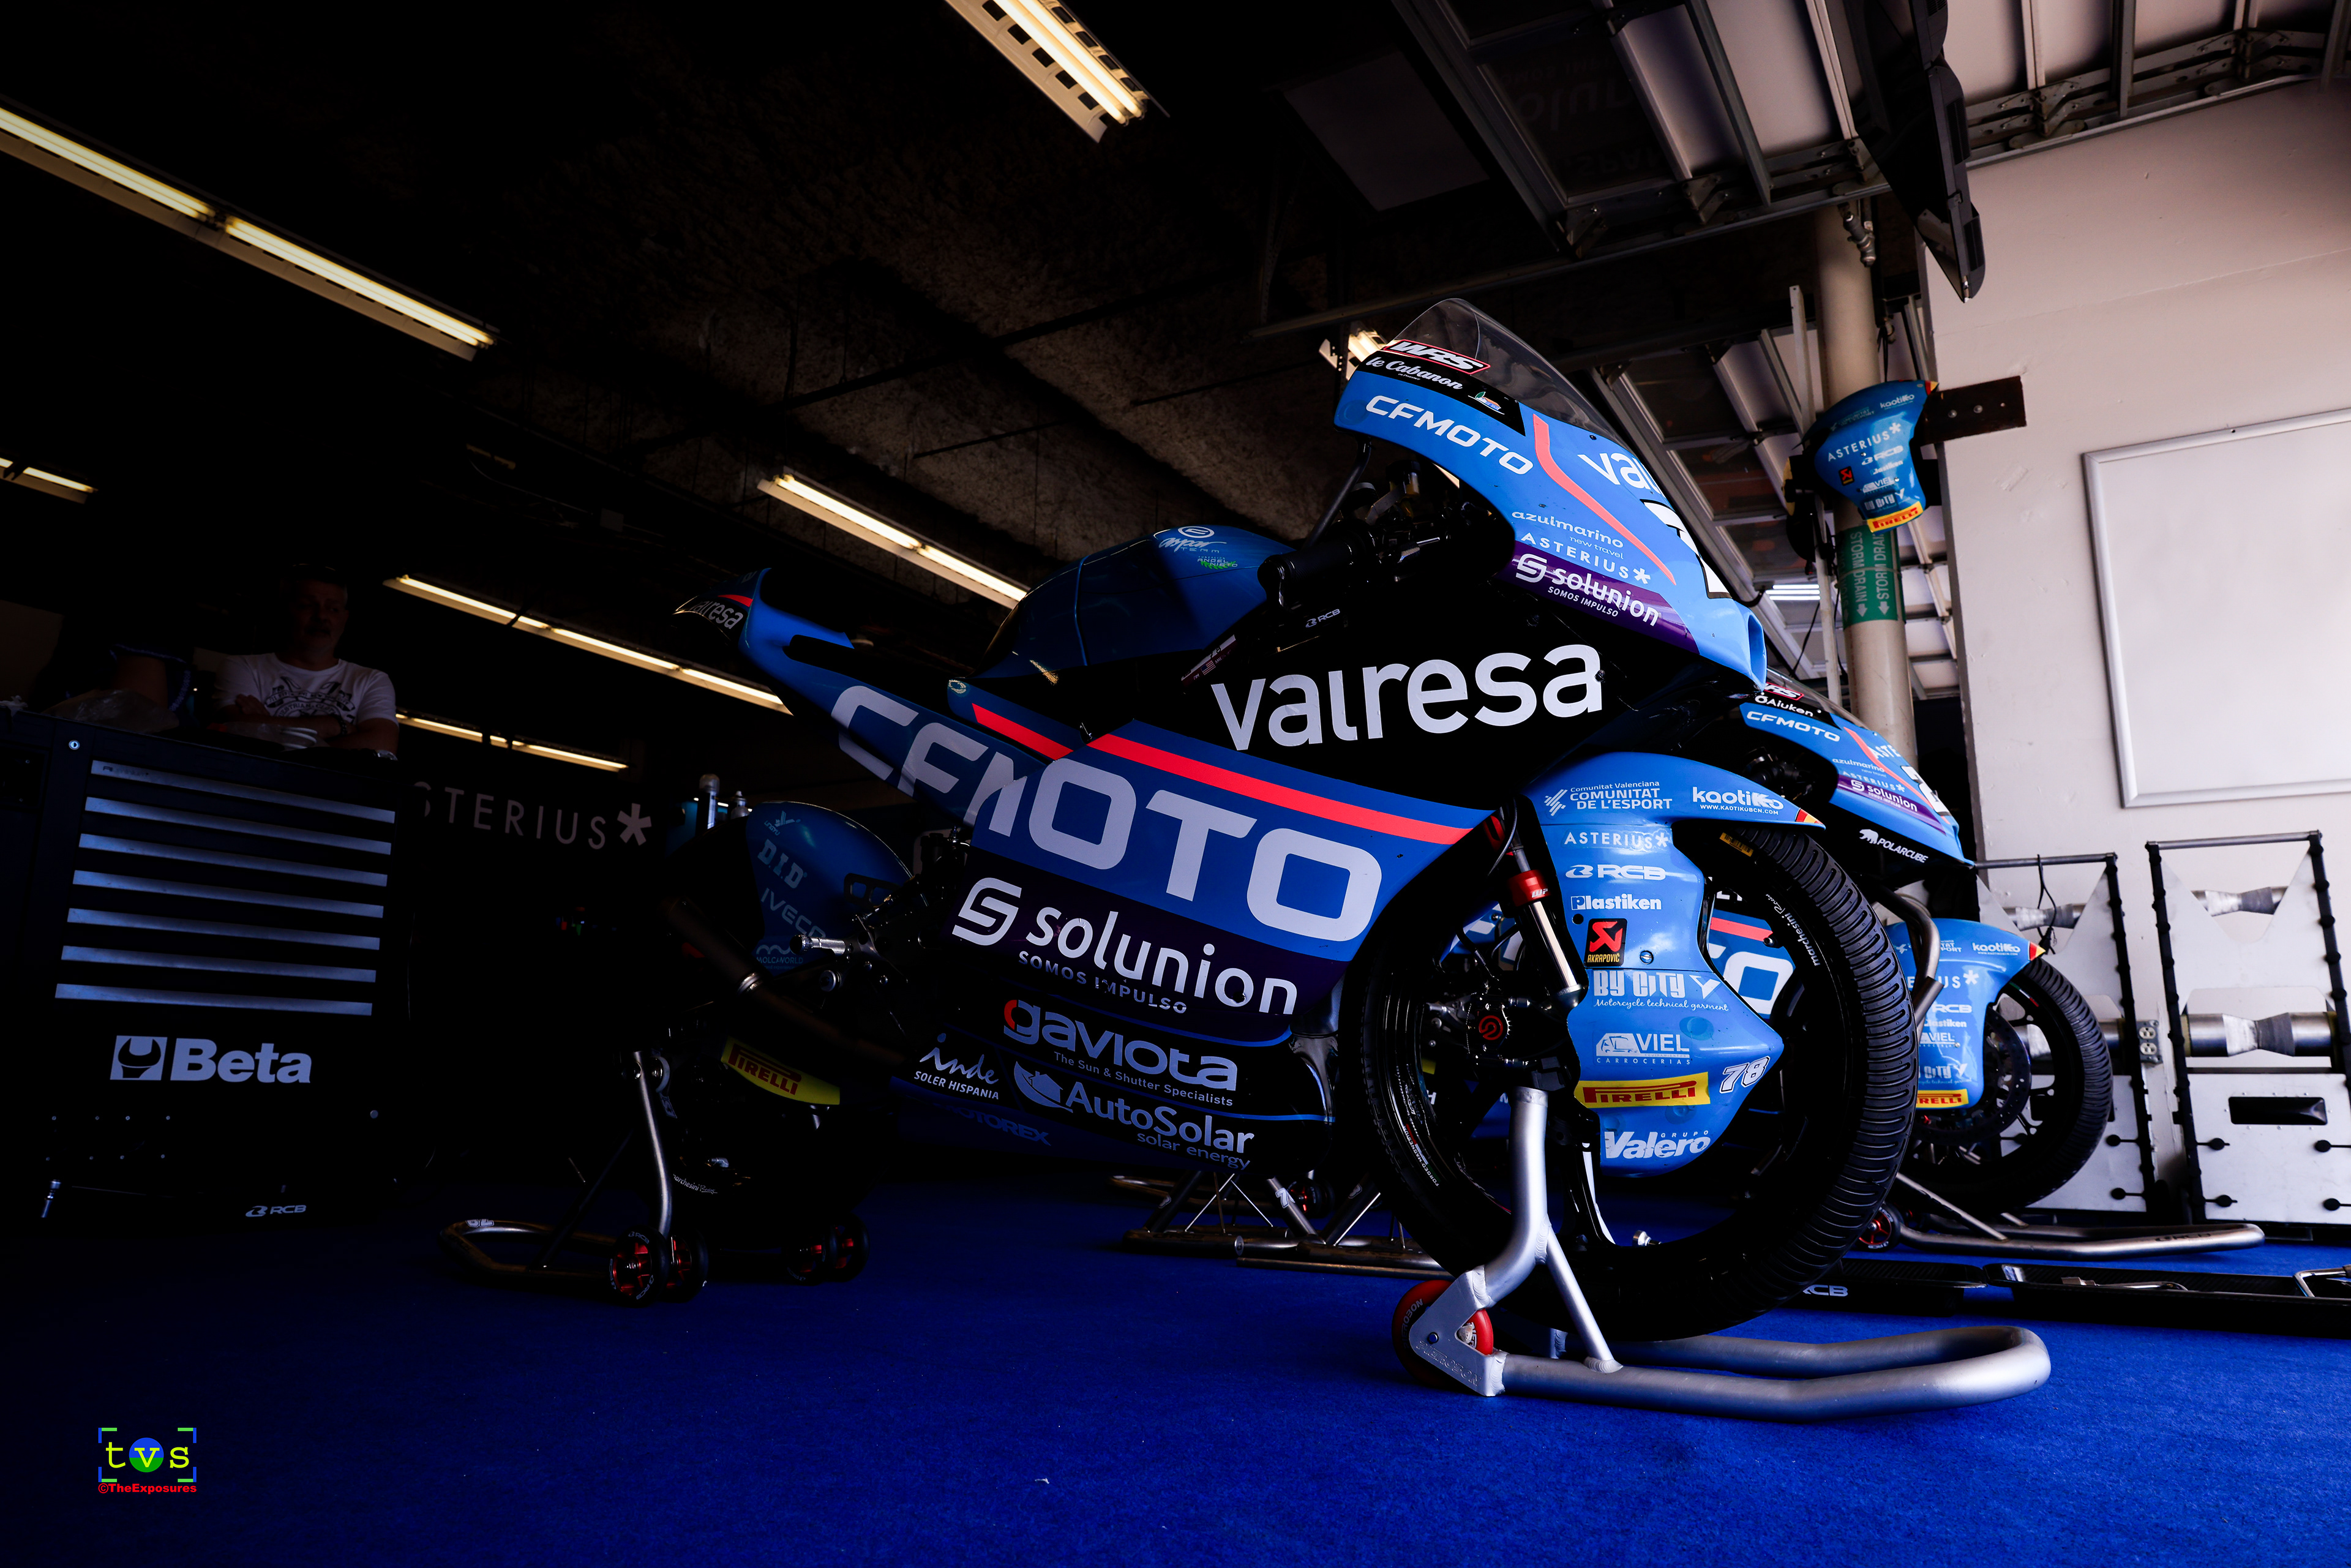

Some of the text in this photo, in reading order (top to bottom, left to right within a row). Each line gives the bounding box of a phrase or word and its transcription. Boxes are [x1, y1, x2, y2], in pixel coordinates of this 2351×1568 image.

[1390, 342, 1483, 370] WRS
[1366, 357, 1463, 389] le Cabanon
[1366, 396, 1533, 475] CFMOTO
[1874, 445, 1903, 461] RCB
[1512, 511, 1624, 548] azulmarino
[1570, 536, 1624, 560] new travel
[1850, 531, 1867, 602] STORM DRAIN
[1875, 563, 1889, 599] STORM
[1548, 586, 1619, 617] SOMOS IMPULSO
[1551, 568, 1660, 627] solunion
[1317, 609, 1341, 623] RCB
[1747, 711, 1840, 742] CFMOTO
[1832, 758, 1885, 773] azulmarino
[1570, 781, 1660, 793] Comunitat Valenciana
[1570, 788, 1660, 801] COMUNITAT
[1867, 785, 1918, 812] solunion
[413, 781, 607, 850] STERIUS
[830, 685, 1382, 942] CFMOTO
[1577, 800, 1599, 809] DE
[1700, 804, 1779, 816] WWW.KAOTIKOBCN.COM
[1877, 838, 1929, 863] POLARCUBE
[1597, 864, 1666, 880] RCB
[1782, 912, 1821, 966] marchesini
[1026, 906, 1298, 1015] solunion
[1018, 950, 1187, 1015] SOMOS IMPULSO
[1594, 999, 1645, 1010] Motorcycle
[1647, 999, 1689, 1008] technical
[1932, 1004, 1973, 1013] RCB
[1637, 1033, 1690, 1052] VIEL
[1929, 1032, 1955, 1041] VIEL
[170, 1038, 313, 1084] Beta
[728, 1045, 801, 1096] PIRELLI
[1720, 1056, 1771, 1094] 78
[913, 1070, 999, 1100] SOLER HISPANIA
[1054, 1051, 1234, 1108] The Sun & Shutter Specialists
[1583, 1080, 1697, 1103] PIRELLI
[1917, 1093, 1962, 1104] RELLI
[946, 1104, 1052, 1146] OTOREX
[1065, 1081, 1254, 1153] AutoSolar
[1137, 1131, 1250, 1171] solar energy
[1403, 1125, 1422, 1163] MAGNESIUM
[1604, 1131, 1711, 1159] Valero
[1422, 1163, 1439, 1186] FORGED
[270, 1204, 307, 1215] RCB
[1401, 1298, 1423, 1349] PIEROBON
